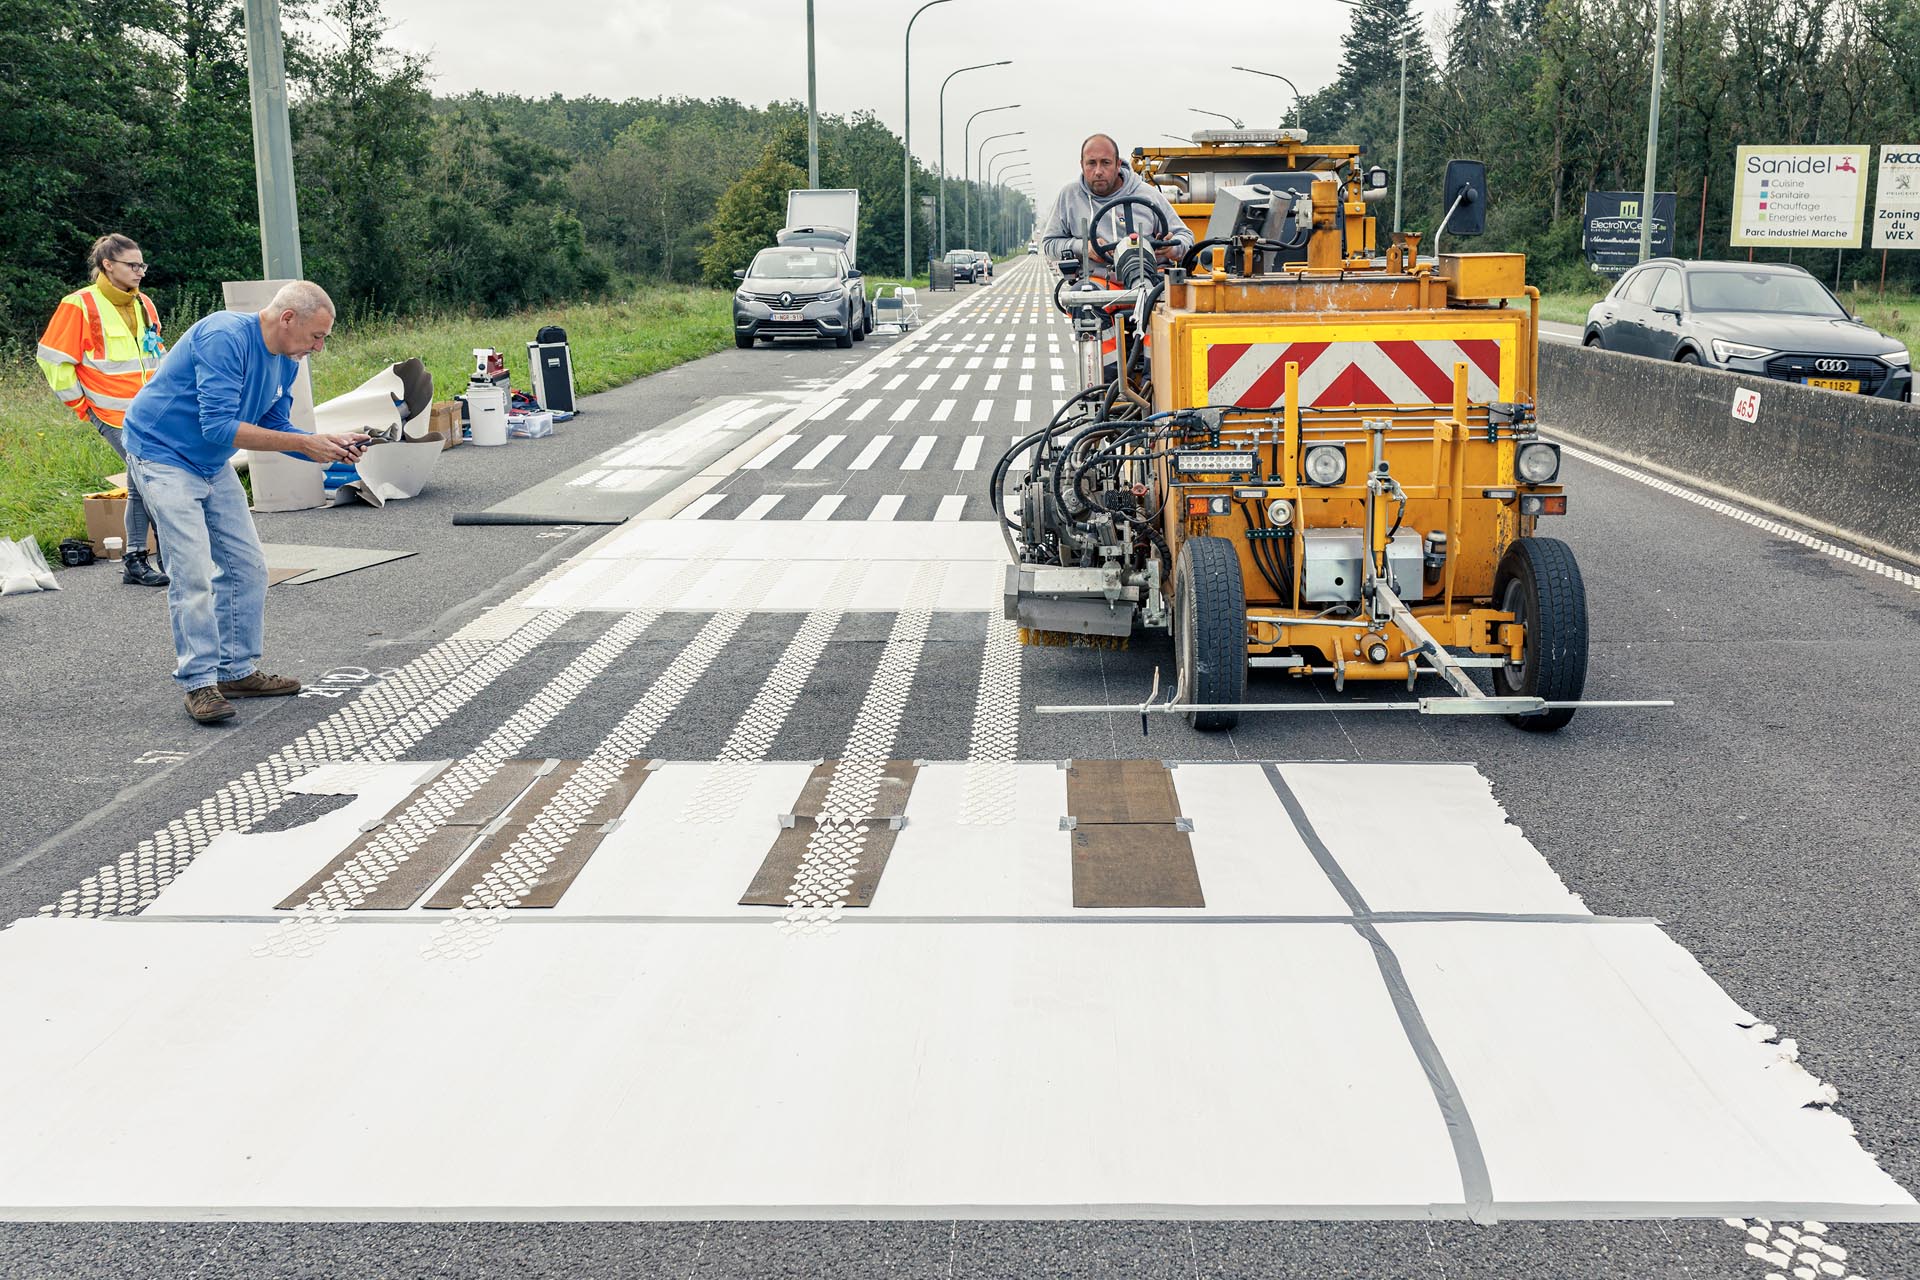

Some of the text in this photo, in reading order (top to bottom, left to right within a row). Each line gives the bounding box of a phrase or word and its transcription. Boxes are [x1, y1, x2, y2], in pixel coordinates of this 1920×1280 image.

[1747, 156, 1831, 174] Sanidel
[1771, 179, 1805, 188] Cuisine
[1770, 191, 1810, 199] Sanitaire
[1769, 202, 1821, 211] Chauffage
[1769, 213, 1837, 223] Energies vertes
[1879, 209, 1920, 221] Zoning
[1891, 220, 1906, 229] du
[1745, 228, 1766, 237] Parc
[1811, 229, 1848, 238] Marche
[1885, 231, 1914, 240] WEX
